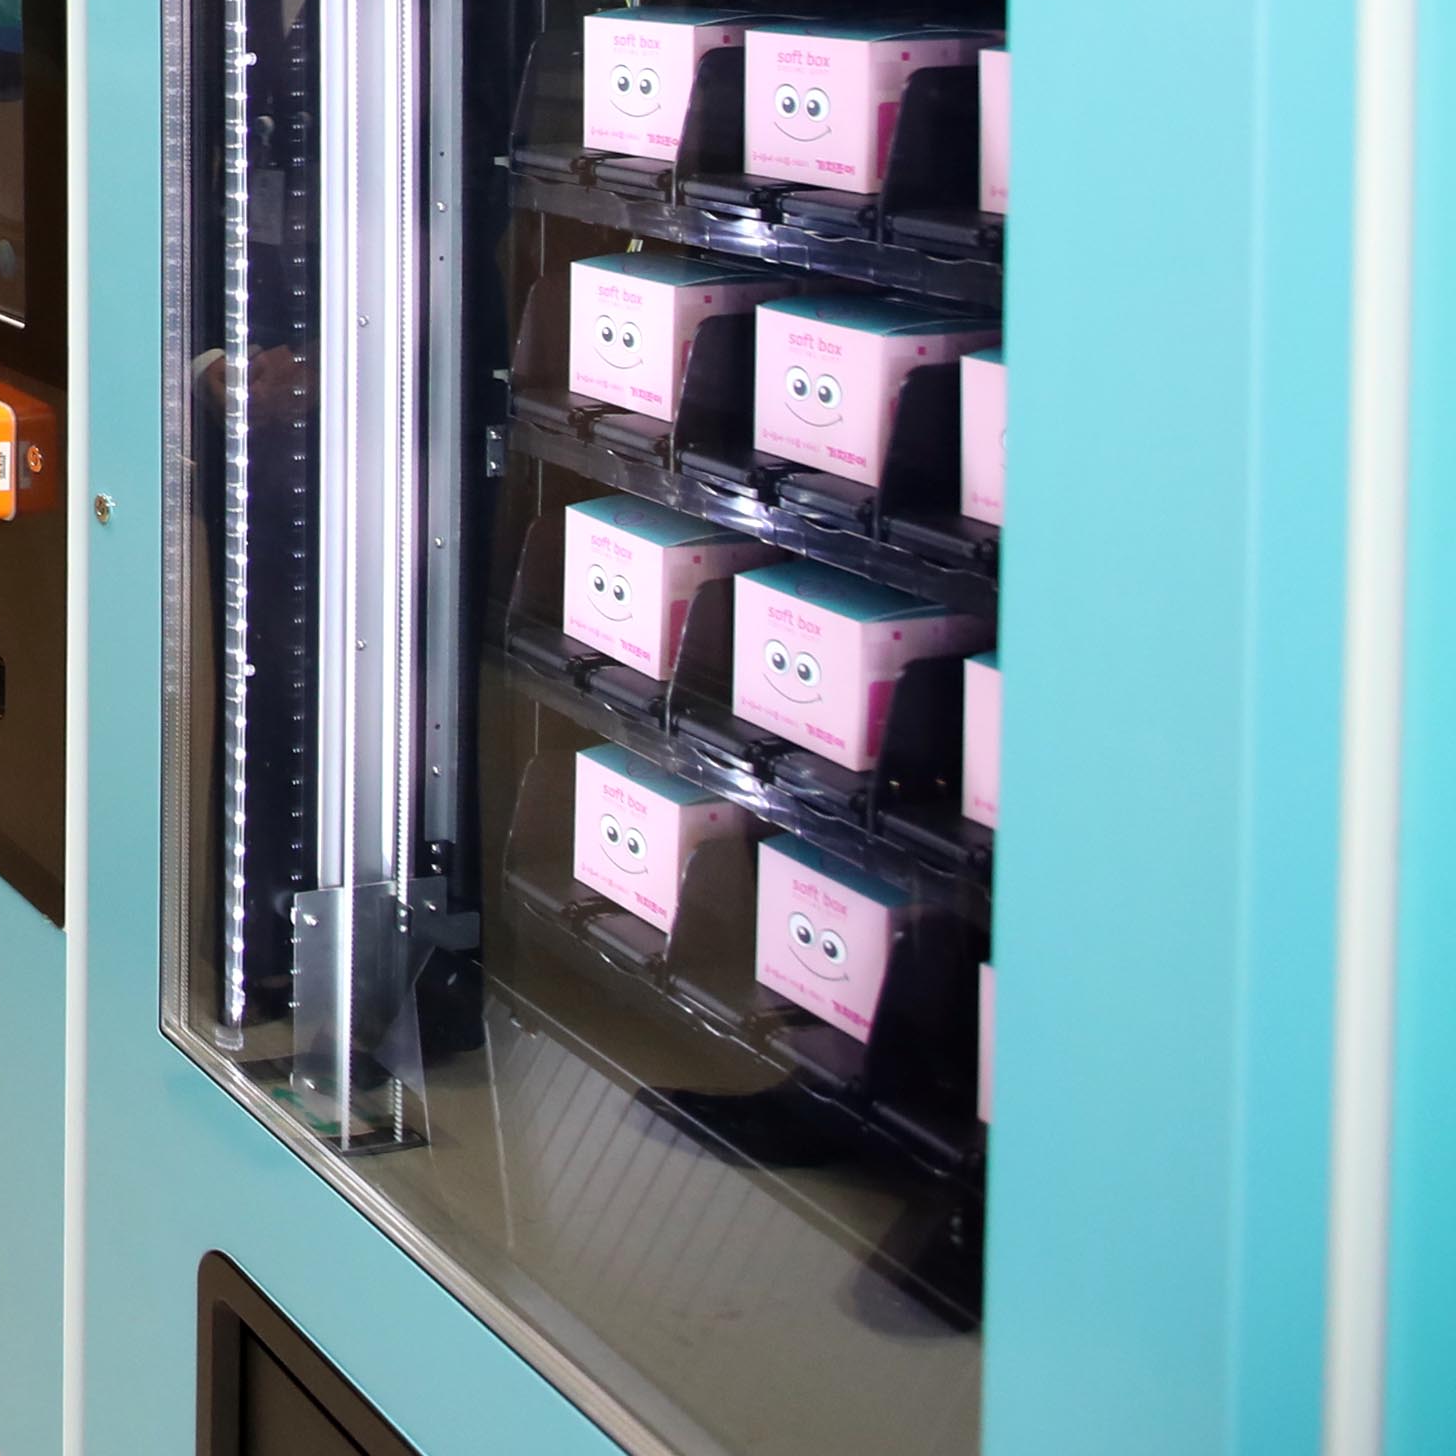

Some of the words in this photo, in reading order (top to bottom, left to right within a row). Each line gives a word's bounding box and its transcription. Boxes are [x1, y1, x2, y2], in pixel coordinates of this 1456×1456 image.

[613, 33, 636, 47] soft
[639, 35, 661, 49] box
[777, 49, 803, 66] soft
[807, 51, 831, 68] box
[788, 332, 815, 350] soft
[818, 337, 843, 356] box
[768, 606, 794, 626] soft
[798, 614, 822, 636] box
[602, 784, 625, 804] soft
[627, 793, 648, 814] box
[792, 879, 818, 900] soft
[823, 893, 848, 916] box
